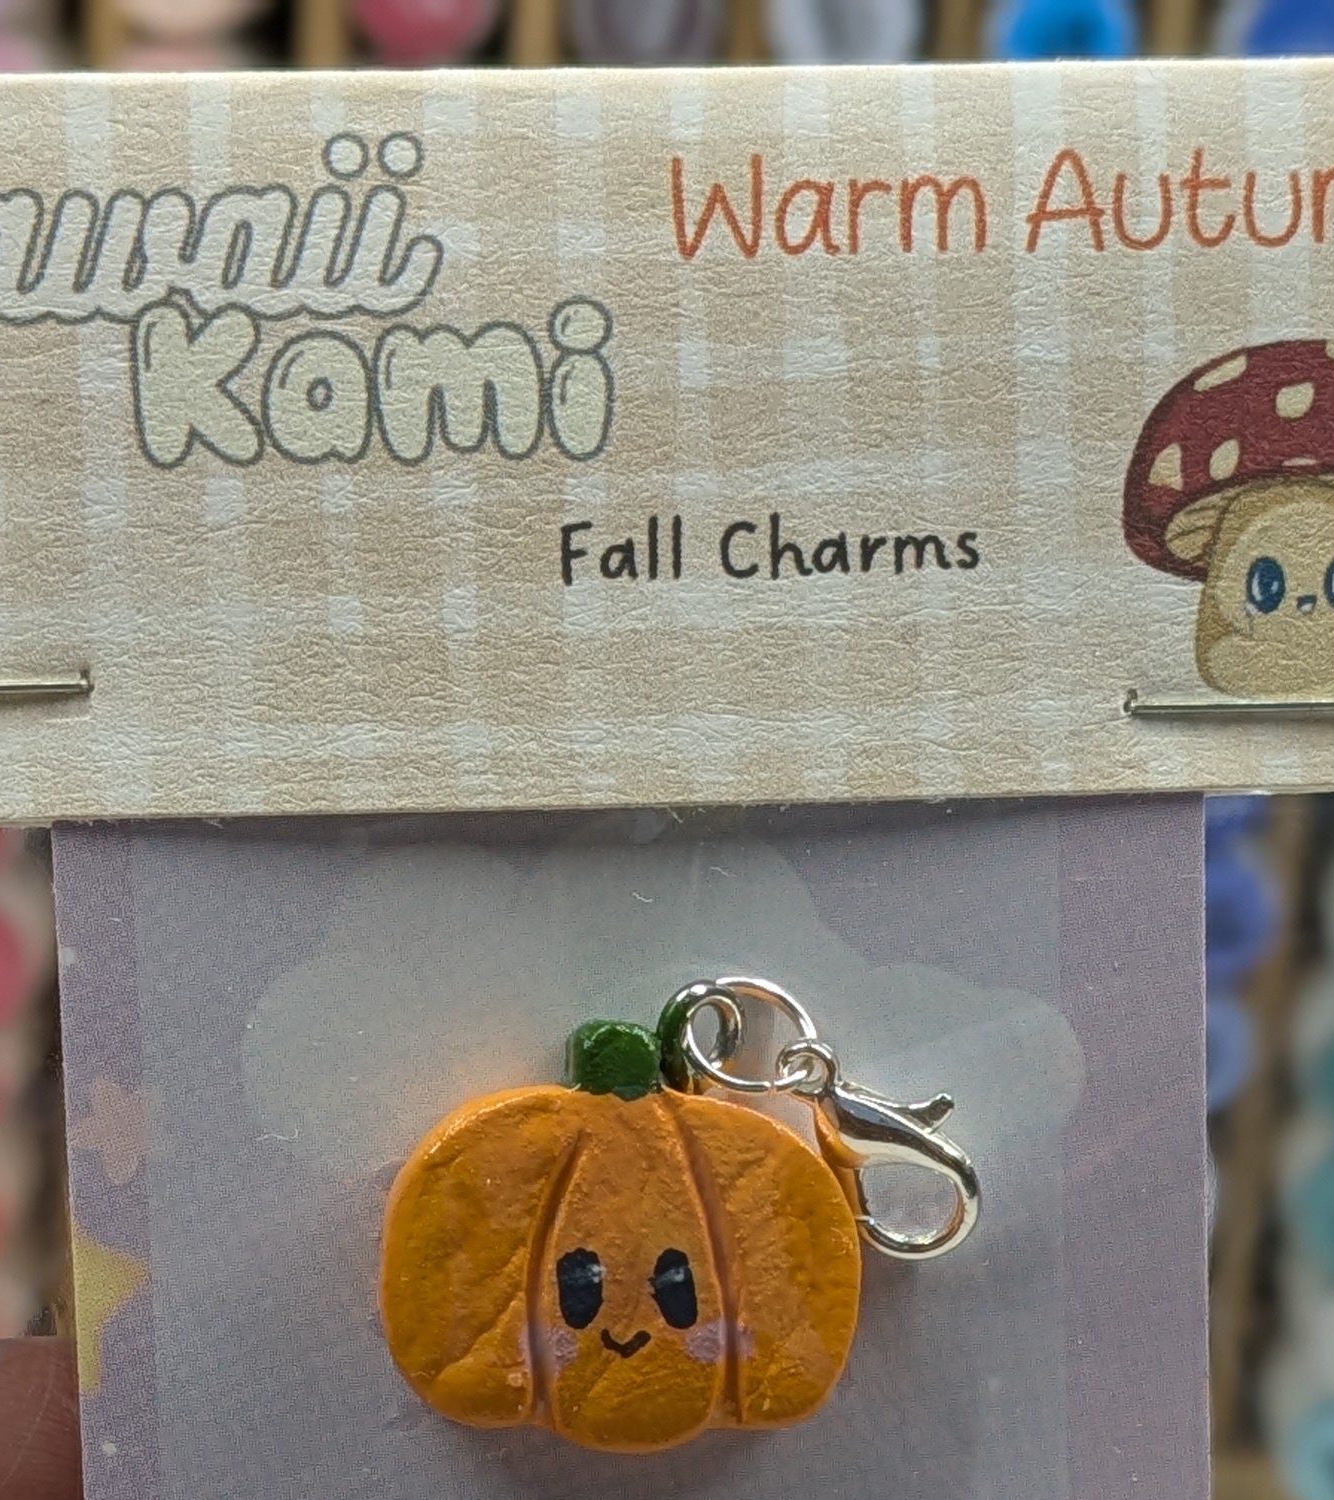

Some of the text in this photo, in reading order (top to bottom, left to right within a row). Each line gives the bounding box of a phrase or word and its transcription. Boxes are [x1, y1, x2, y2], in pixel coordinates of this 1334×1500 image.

[668, 153, 988, 262] Warm
[130, 295, 615, 468] Kami
[558, 511, 983, 587] Fall Charms
